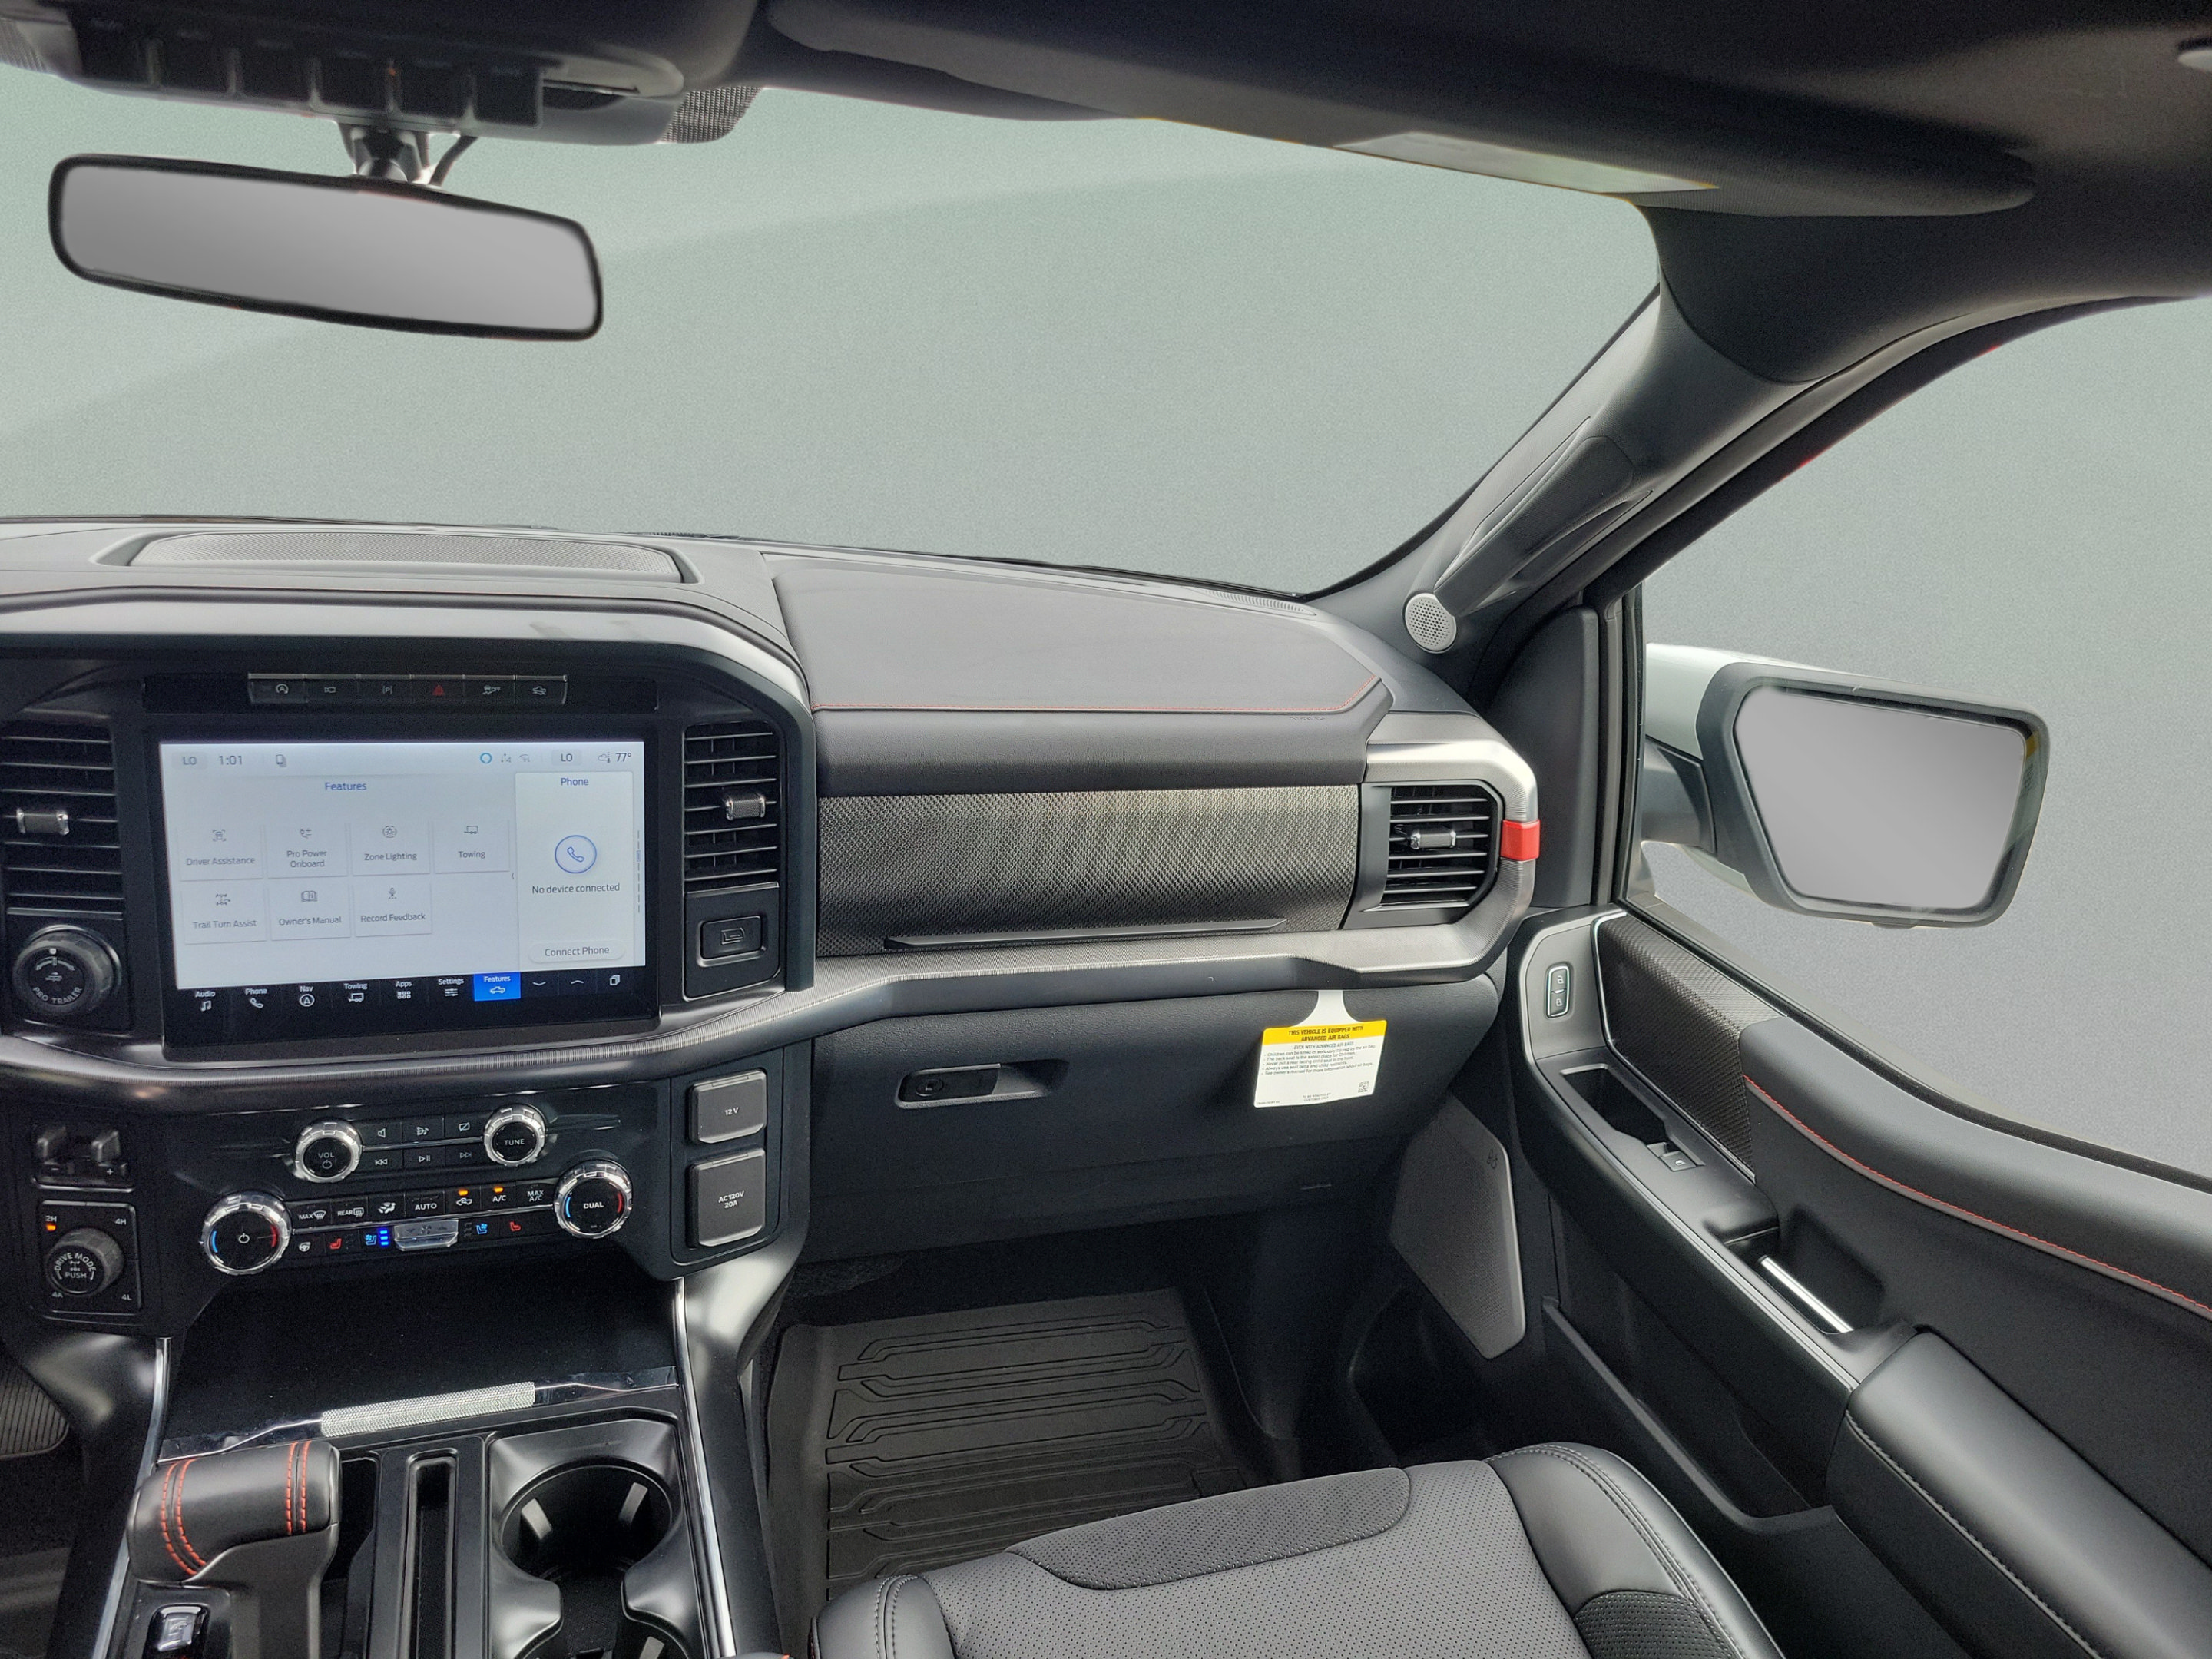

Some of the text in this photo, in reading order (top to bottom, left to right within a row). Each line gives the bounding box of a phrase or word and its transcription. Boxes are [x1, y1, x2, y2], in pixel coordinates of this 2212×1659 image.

[182, 756, 197, 766] LO
[217, 754, 243, 766] 1:01
[560, 753, 573, 762] LO
[324, 781, 367, 791] Features
[560, 777, 589, 786] Phone
[286, 849, 327, 858] Pro Power
[363, 852, 418, 862] Zone Lighting
[458, 850, 486, 859] Towing
[186, 856, 256, 866] Driver Assistance
[290, 859, 325, 868] Onboard
[531, 883, 621, 895] No device connected
[278, 916, 342, 926] Owner's Manual
[360, 912, 426, 922] Record Feedback
[193, 919, 257, 929] Trail Turn Assist
[545, 945, 610, 957] Connect Phone
[437, 978, 465, 986] Settings
[483, 975, 511, 983] Features
[343, 982, 368, 991] Towing
[395, 980, 412, 988] Apps
[32, 986, 83, 1004] PRO TRAILER
[245, 987, 268, 995] Phone
[492, 1194, 507, 1203] A/C
[415, 1202, 438, 1211] AUTO
[724, 1200, 738, 1209] 20A
[54, 1252, 97, 1272] DRIVE MODE
